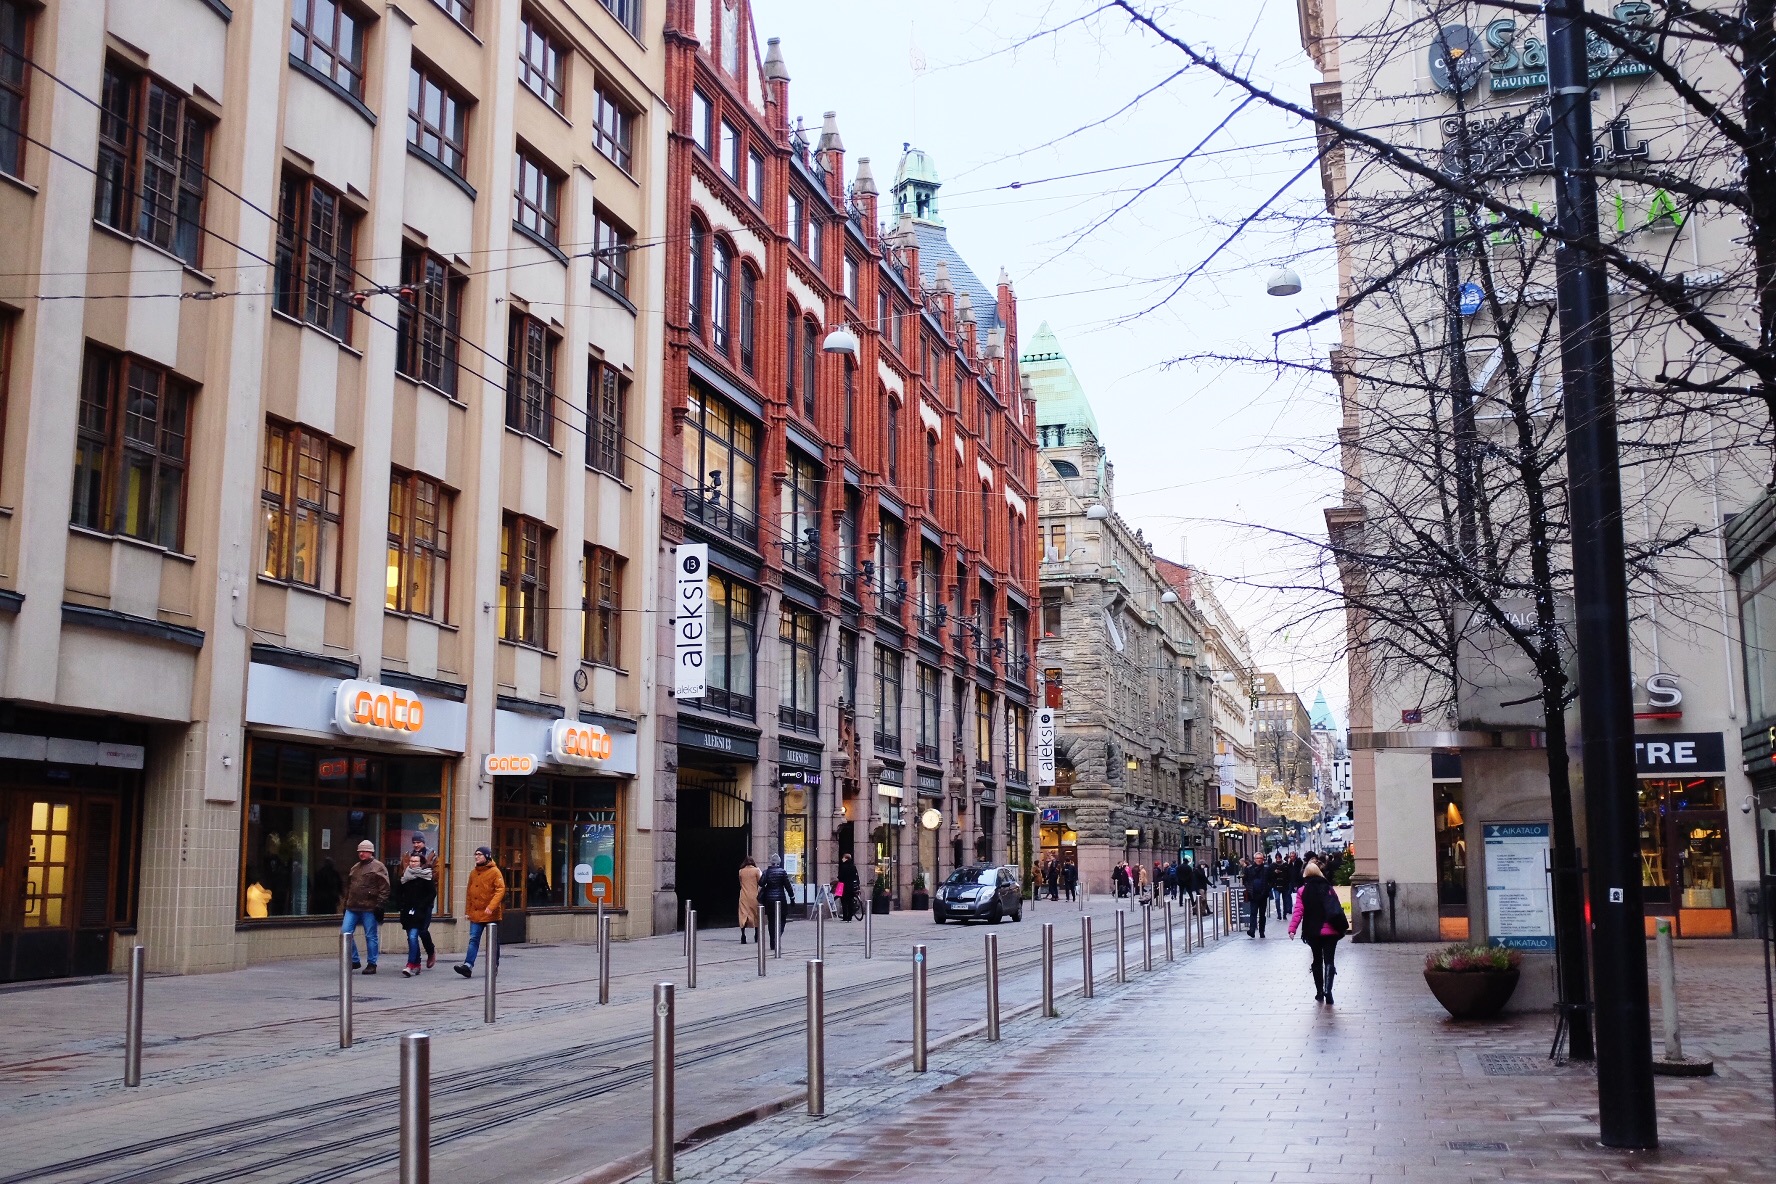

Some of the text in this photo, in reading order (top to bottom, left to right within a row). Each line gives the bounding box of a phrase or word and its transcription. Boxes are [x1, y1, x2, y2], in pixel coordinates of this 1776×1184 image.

[1493, 74, 1548, 89] RAVINTO
[677, 558, 703, 668] aleksi 13
[1472, 611, 1539, 627] ATALO
[677, 684, 698, 695] aleksi
[354, 690, 424, 732] sato
[565, 727, 612, 760] sato
[1039, 726, 1053, 770] aleksi
[488, 755, 531, 771] sato
[1503, 826, 1541, 835] AIKATALO
[1508, 939, 1548, 947] AIKATALO
